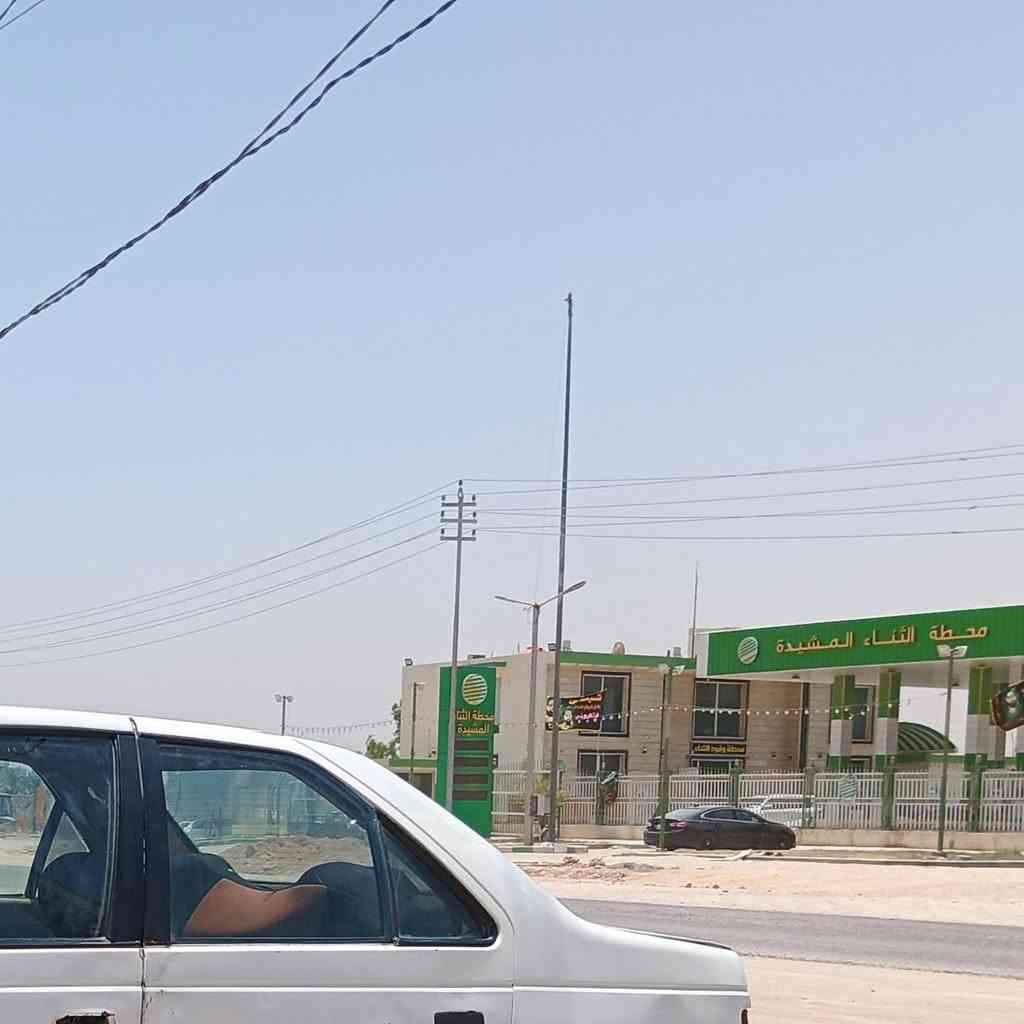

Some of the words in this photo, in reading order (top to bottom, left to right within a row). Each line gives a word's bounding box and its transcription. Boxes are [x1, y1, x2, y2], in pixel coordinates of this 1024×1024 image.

[863, 625, 915, 646] الثناء
[929, 624, 989, 641] محطة
[775, 632, 853, 655] المشيدة
[455, 709, 471, 721] الثنا
